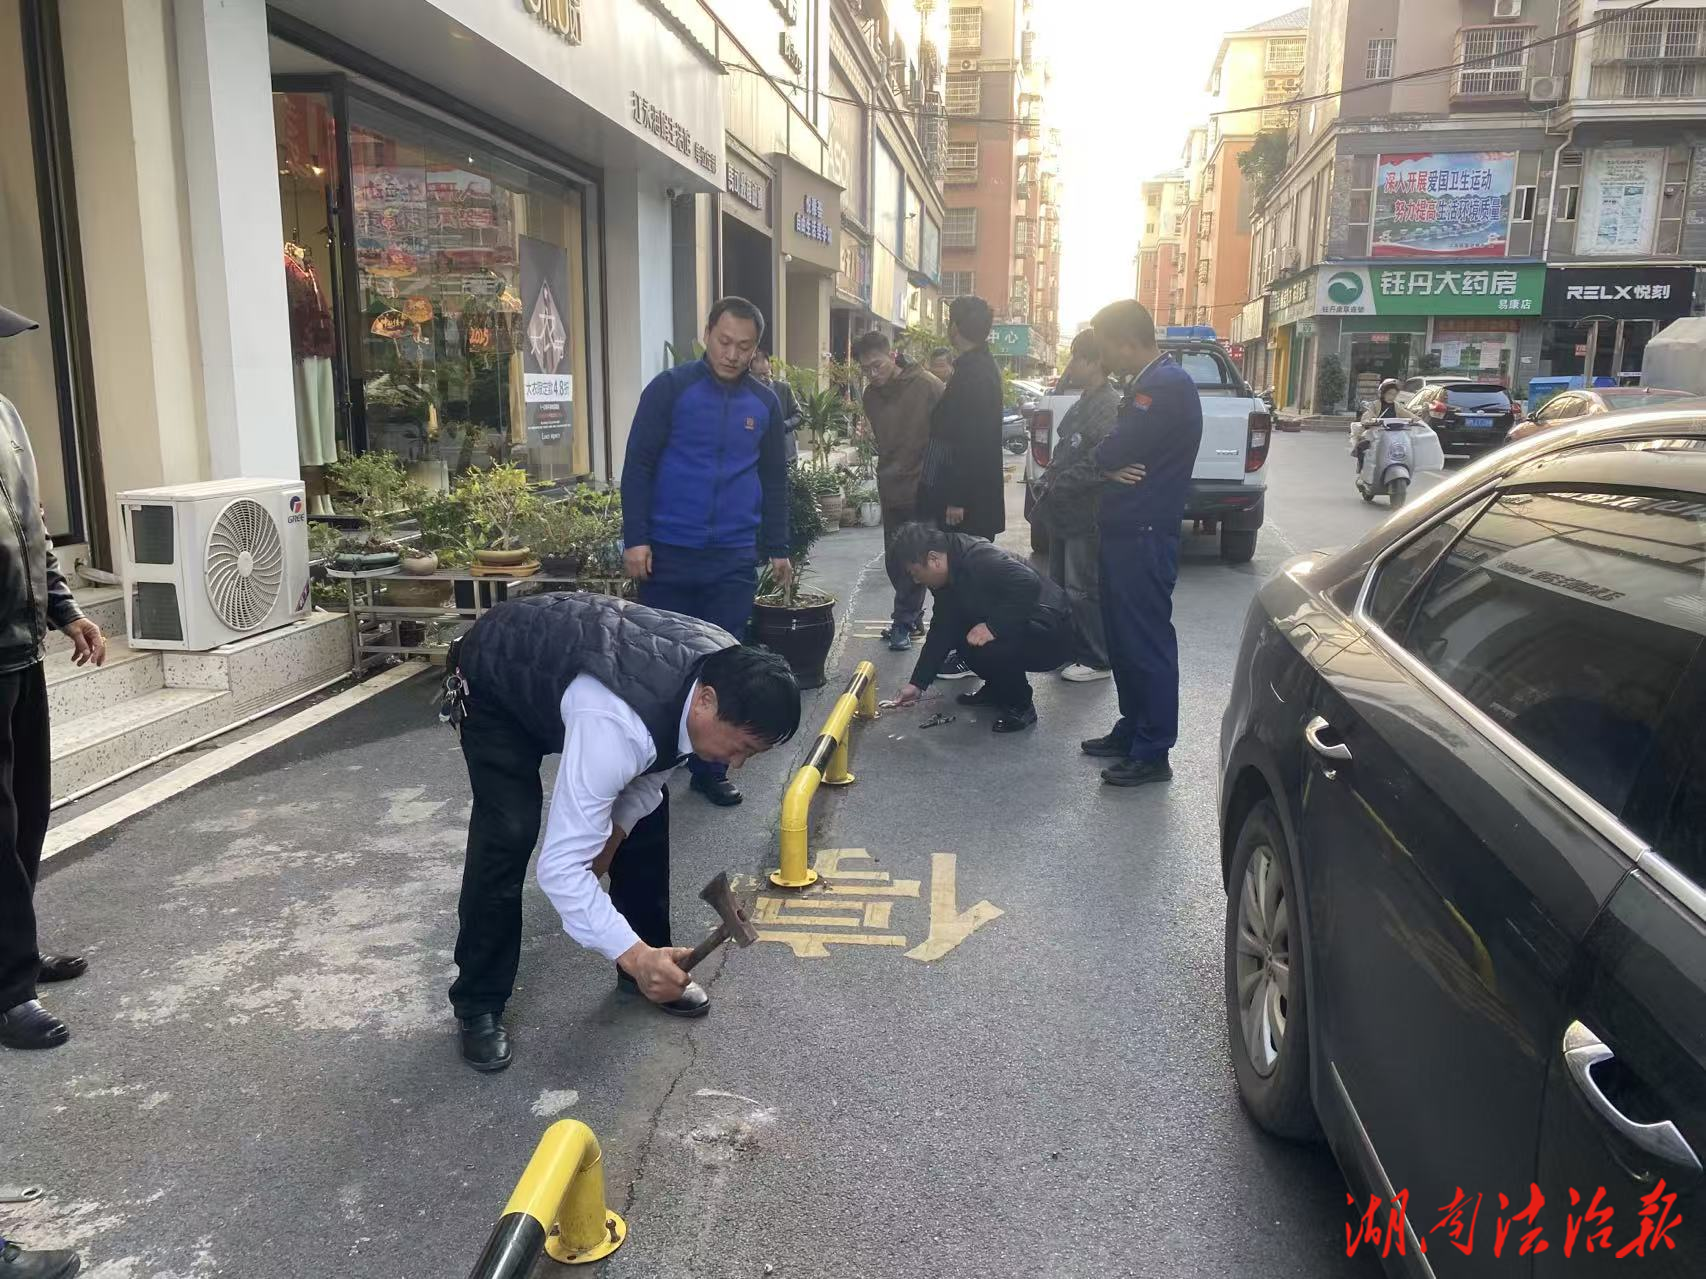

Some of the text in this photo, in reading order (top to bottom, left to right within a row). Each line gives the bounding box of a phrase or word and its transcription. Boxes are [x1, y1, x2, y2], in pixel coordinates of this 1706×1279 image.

[1384, 168, 1492, 193] 深入开展爱国卫生运动
[1394, 199, 1502, 222] 努力提高生活环境质量
[1380, 270, 1518, 295] 钰丹大药房
[1567, 285, 1633, 300] RELX
[1498, 299, 1532, 310] 易康店
[287, 514, 305, 524] GREE
